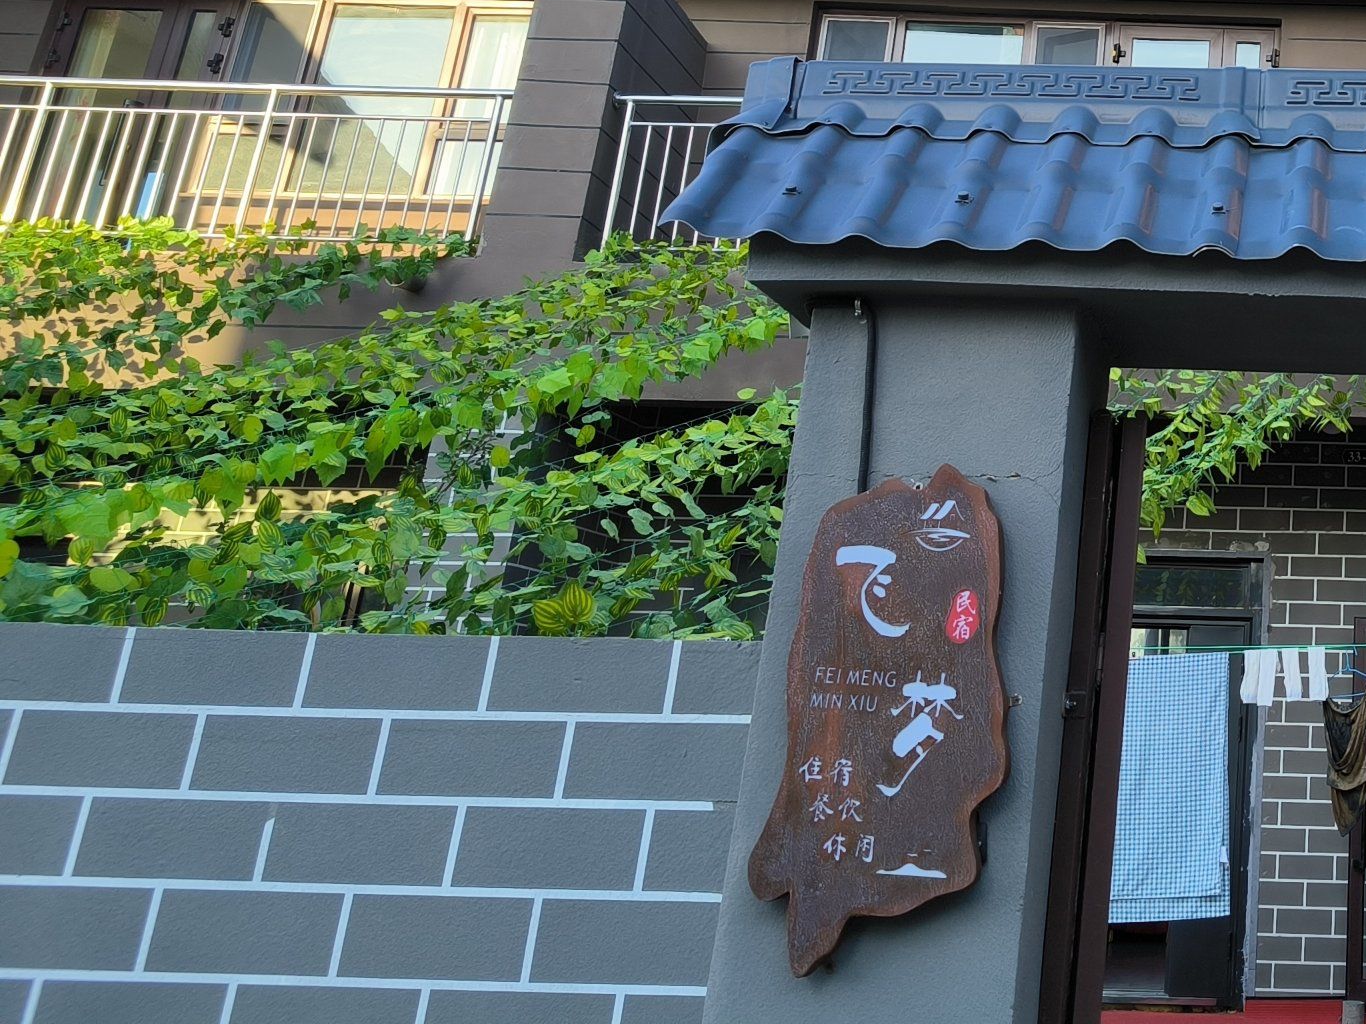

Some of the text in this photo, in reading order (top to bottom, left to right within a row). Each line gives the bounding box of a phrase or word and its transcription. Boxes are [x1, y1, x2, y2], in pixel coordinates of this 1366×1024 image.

[952, 590, 976, 640] 民宿
[815, 666, 897, 688] FEI MENG
[809, 693, 878, 712] MIN XIU
[809, 792, 863, 823] 餐饮
[823, 833, 875, 863] 休闲
